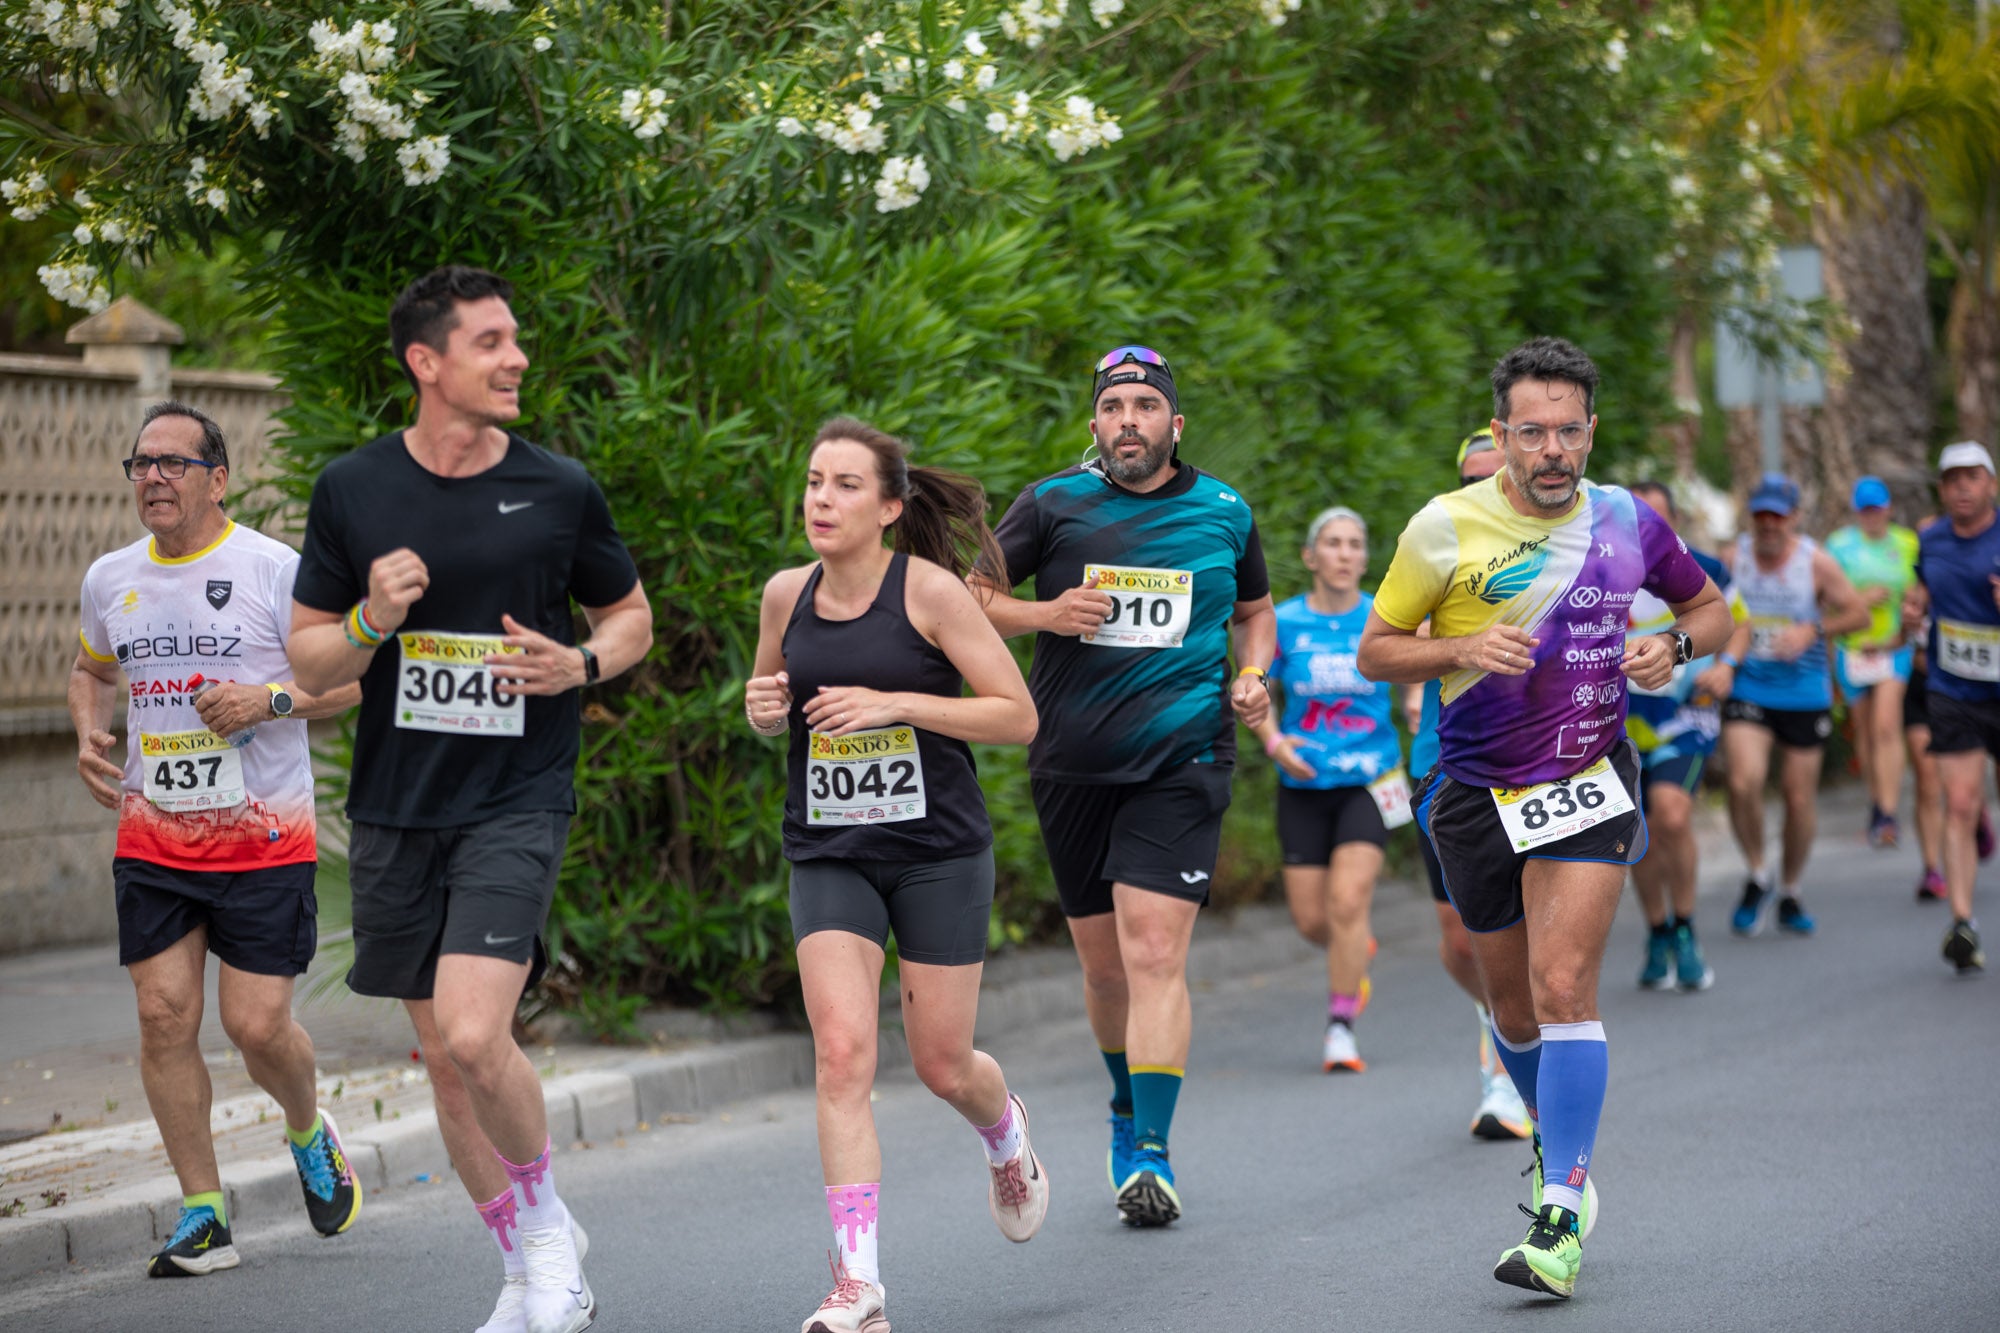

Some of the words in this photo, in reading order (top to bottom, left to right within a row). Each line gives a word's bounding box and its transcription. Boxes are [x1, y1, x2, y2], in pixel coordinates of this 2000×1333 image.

[1099, 571, 1116, 585] 38
[1116, 576, 1170, 589] FONDO
[1565, 661, 1609, 671] FITNESS
[162, 737, 213, 751] FONDO
[819, 737, 830, 753] 38
[832, 735, 851, 743] GRAN
[852, 734, 883, 743] PREMIO
[831, 739, 890, 755] FONDO
[154, 755, 223, 791] 437
[810, 760, 919, 801] 3042
[1520, 781, 1606, 830] 836
